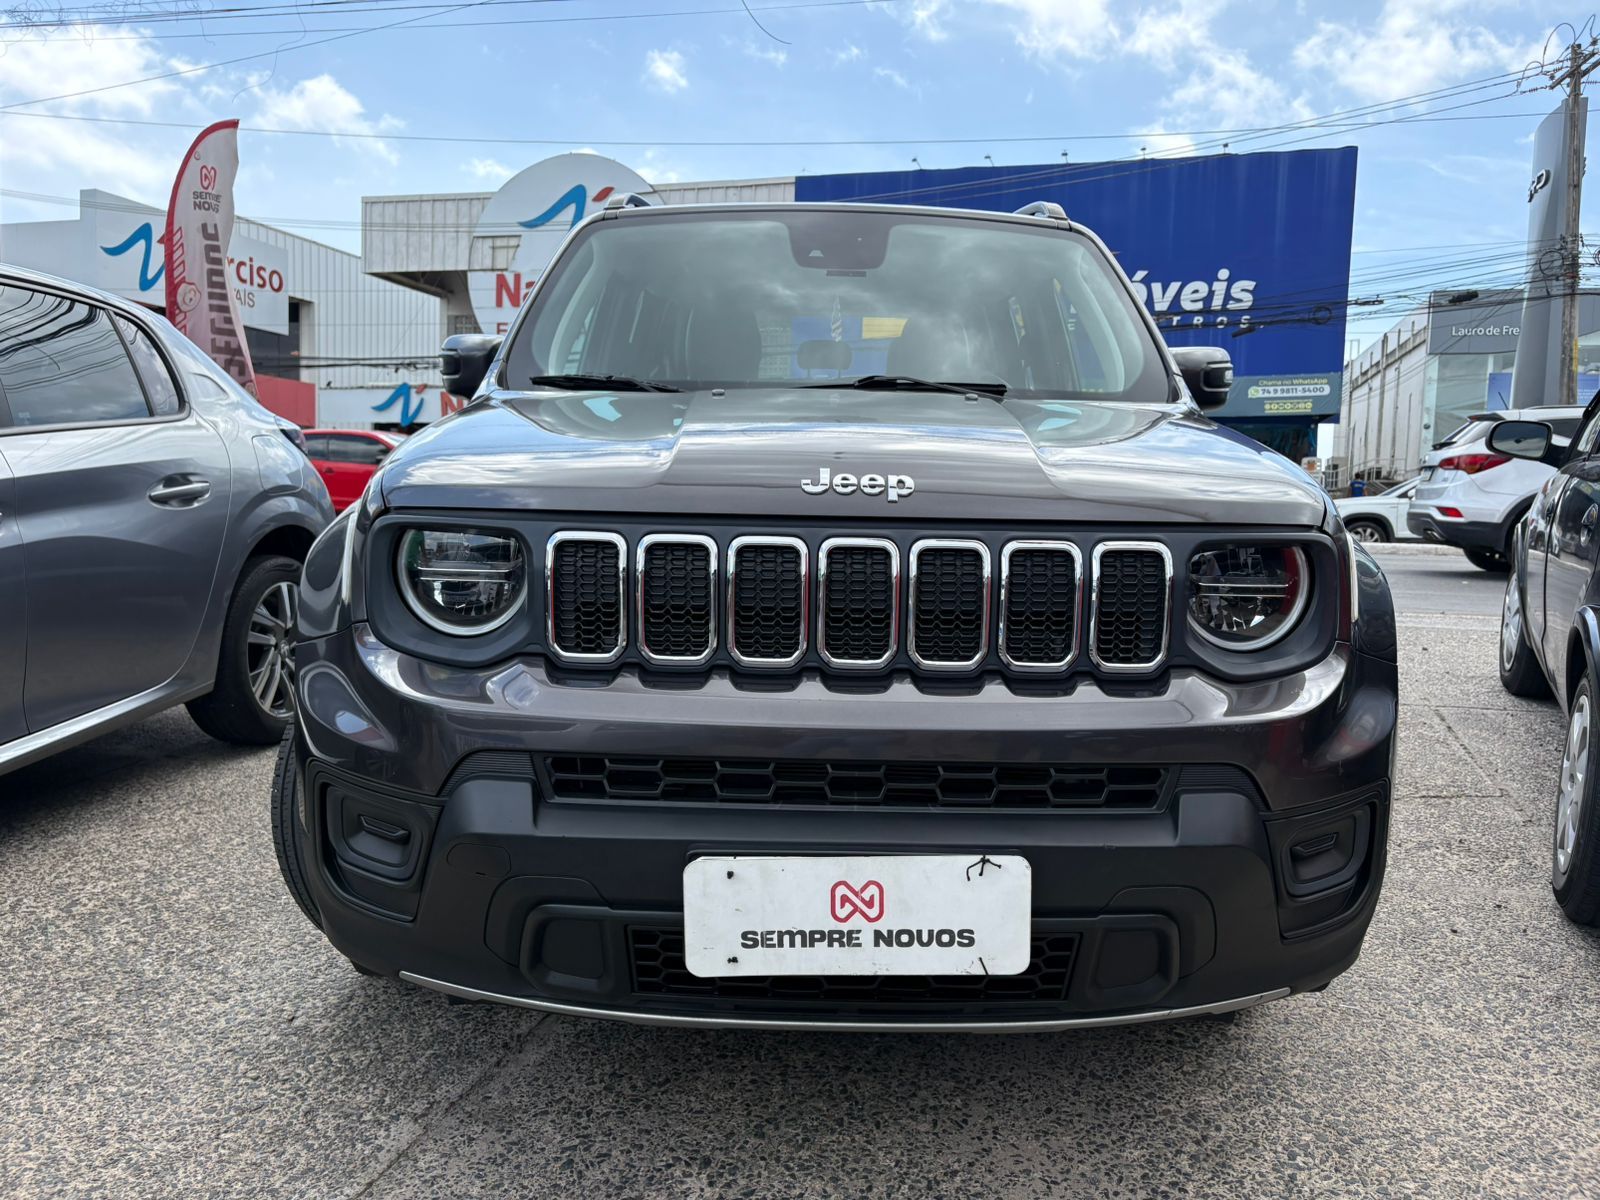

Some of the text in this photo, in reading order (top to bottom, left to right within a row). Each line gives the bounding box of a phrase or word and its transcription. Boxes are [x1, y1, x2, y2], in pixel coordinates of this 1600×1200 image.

[193, 191, 222, 203] SEMRE
[193, 201, 220, 213] NOVS
[234, 288, 256, 308] AIS
[1452, 325, 1520, 336] Lauro de Fre
[800, 467, 915, 503] Jeep
[740, 928, 975, 949] SEMPRE NOVOS
